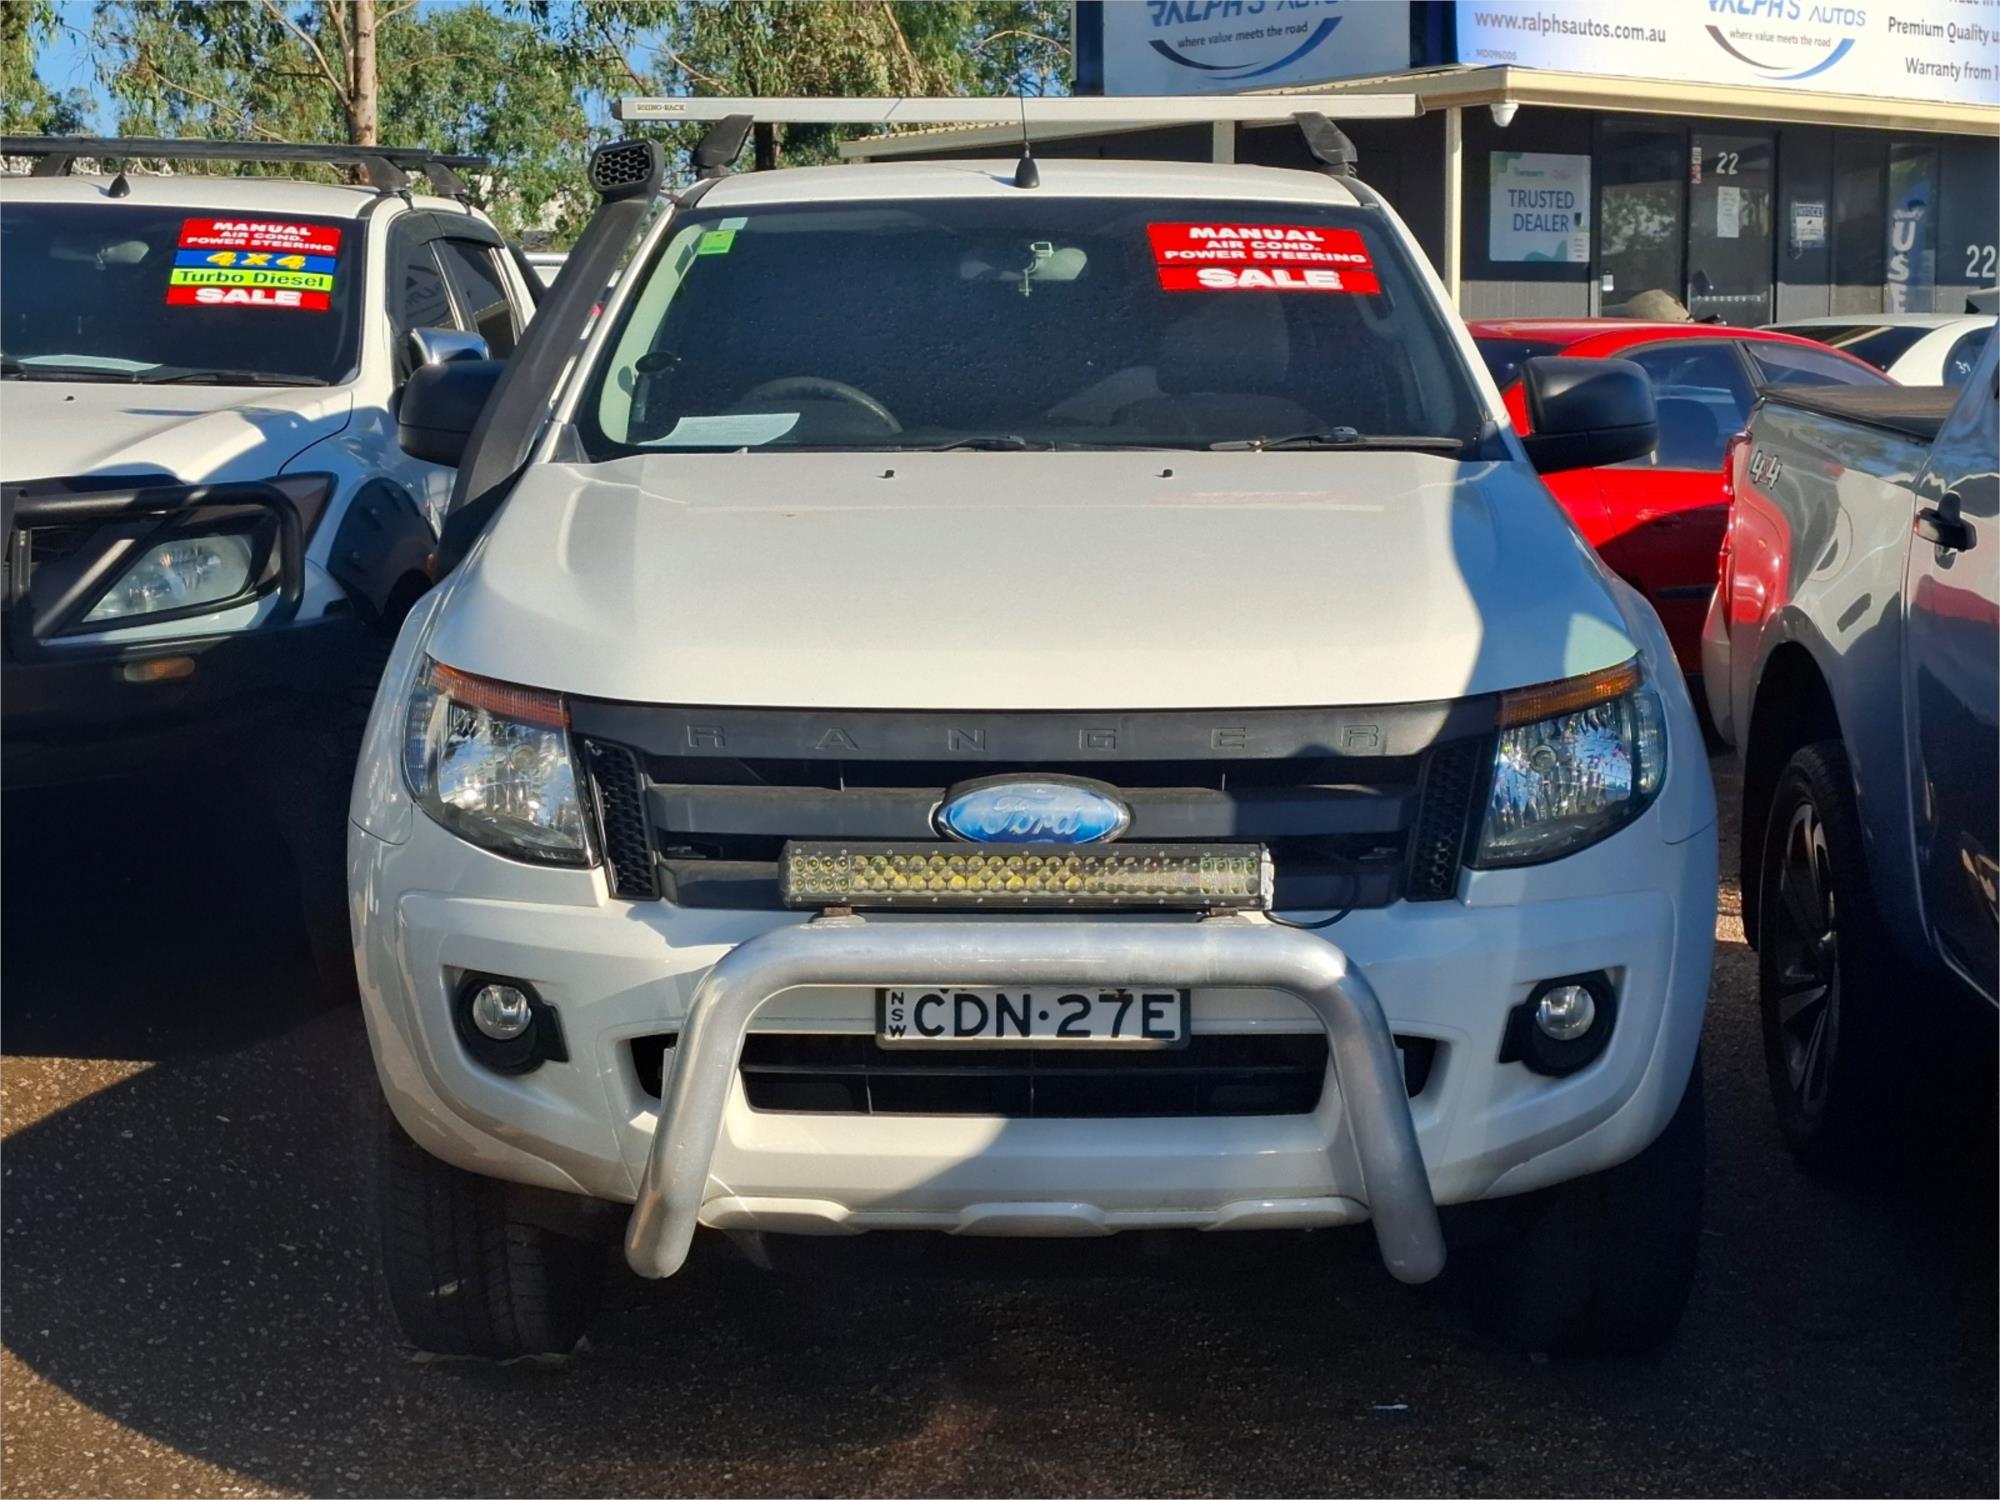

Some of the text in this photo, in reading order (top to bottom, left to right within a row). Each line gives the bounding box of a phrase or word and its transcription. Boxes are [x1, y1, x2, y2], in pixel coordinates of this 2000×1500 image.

[1147, 0, 1266, 27] RALPH
[1808, 5, 1867, 27] AUTOS
[1177, 21, 1308, 48] where value meets the road
[1474, 11, 1667, 43] www.ralphsautos.com.au
[1729, 28, 1831, 48] where value meets the road
[1887, 15, 1944, 38] Premium
[1946, 21, 1990, 46] Quality
[1905, 56, 1961, 82] Warranty
[1963, 60, 1992, 81] from
[1716, 152, 1739, 175] 22
[1507, 189, 1576, 209] TRUSTED
[212, 222, 312, 236] MANUAL
[1512, 213, 1570, 233] DEALER
[186, 237, 335, 252] POWER STEERING
[220, 231, 305, 242] AIR COND.
[1189, 227, 1325, 242] MANUAL
[1206, 240, 1322, 251] AIR COND.
[1164, 250, 1367, 263] POWER STEERING
[1965, 244, 1997, 279] 22
[179, 270, 325, 288] Turbo Diesel
[1196, 267, 1344, 290] SALE
[194, 287, 303, 307] SALE
[687, 724, 1381, 753] RANGER
[981, 796, 1080, 836] Ford
[888, 991, 907, 1038] NSW
